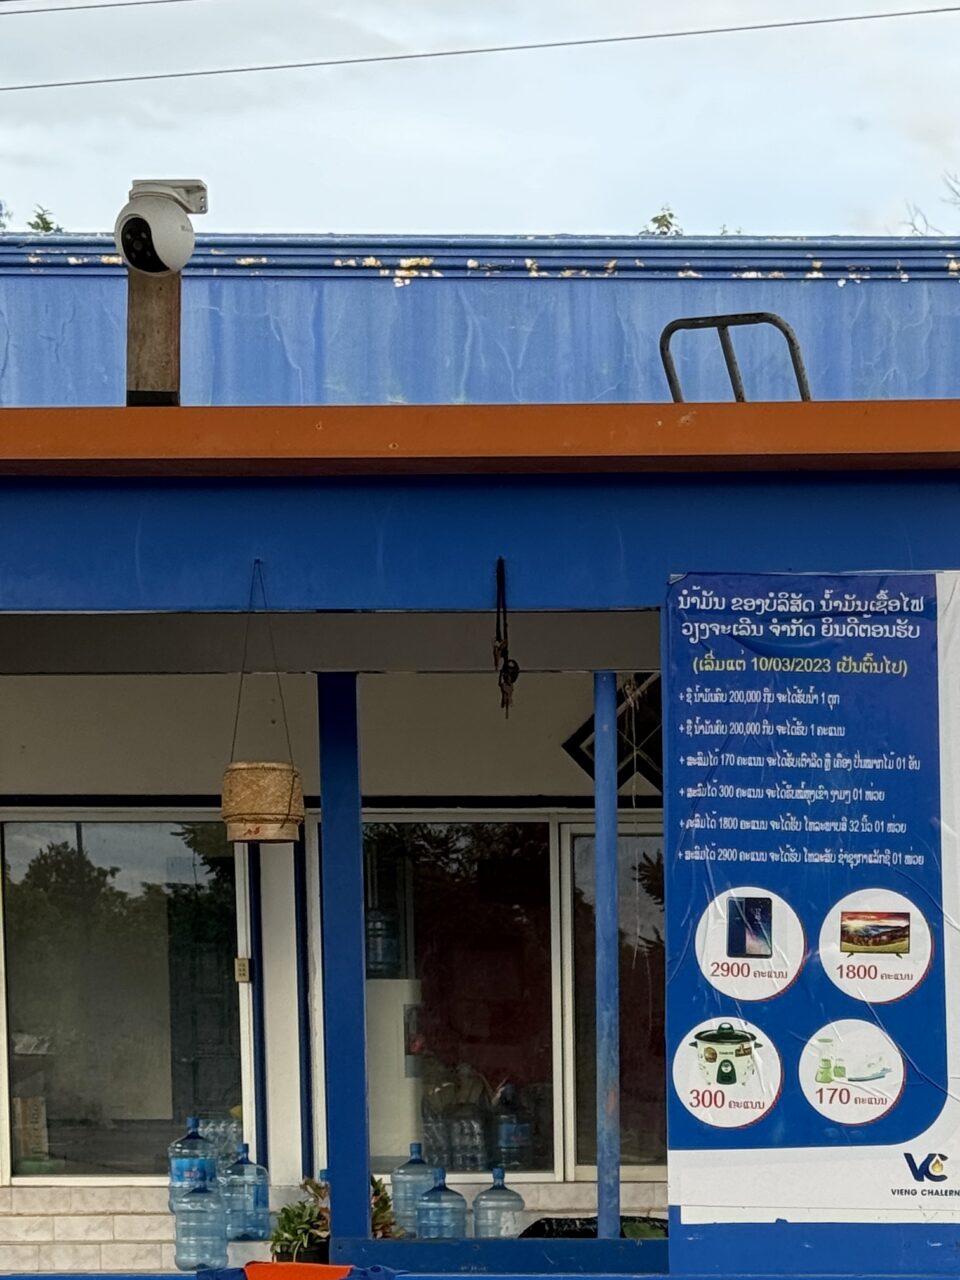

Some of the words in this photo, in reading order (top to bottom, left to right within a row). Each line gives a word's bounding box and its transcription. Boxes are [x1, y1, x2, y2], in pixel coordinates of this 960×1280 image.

[821, 614, 920, 639] ຍິນດີຕ້ອນຮັບ
[751, 656, 832, 673] 10/03/2023
[729, 690, 762, 704] 200,000
[821, 692, 826, 704] 1
[729, 722, 761, 736] 200,000
[810, 724, 815, 736] 1
[720, 754, 736, 766] 170
[896, 757, 906, 770] 01
[718, 784, 734, 798] 300
[852, 788, 862, 801] 01
[718, 816, 738, 830] 1800
[848, 820, 860, 832] 32
[874, 820, 884, 833] 01
[717, 848, 738, 862] 2900
[892, 852, 902, 865] 01
[710, 962, 752, 979] 2900
[836, 964, 878, 980] 1800
[688, 1090, 725, 1109] 300
[815, 1088, 850, 1106] 170
[903, 1152, 949, 1182] VC
[890, 1188, 918, 1196] VIENG
[920, 1188, 960, 1197] CHALERN
